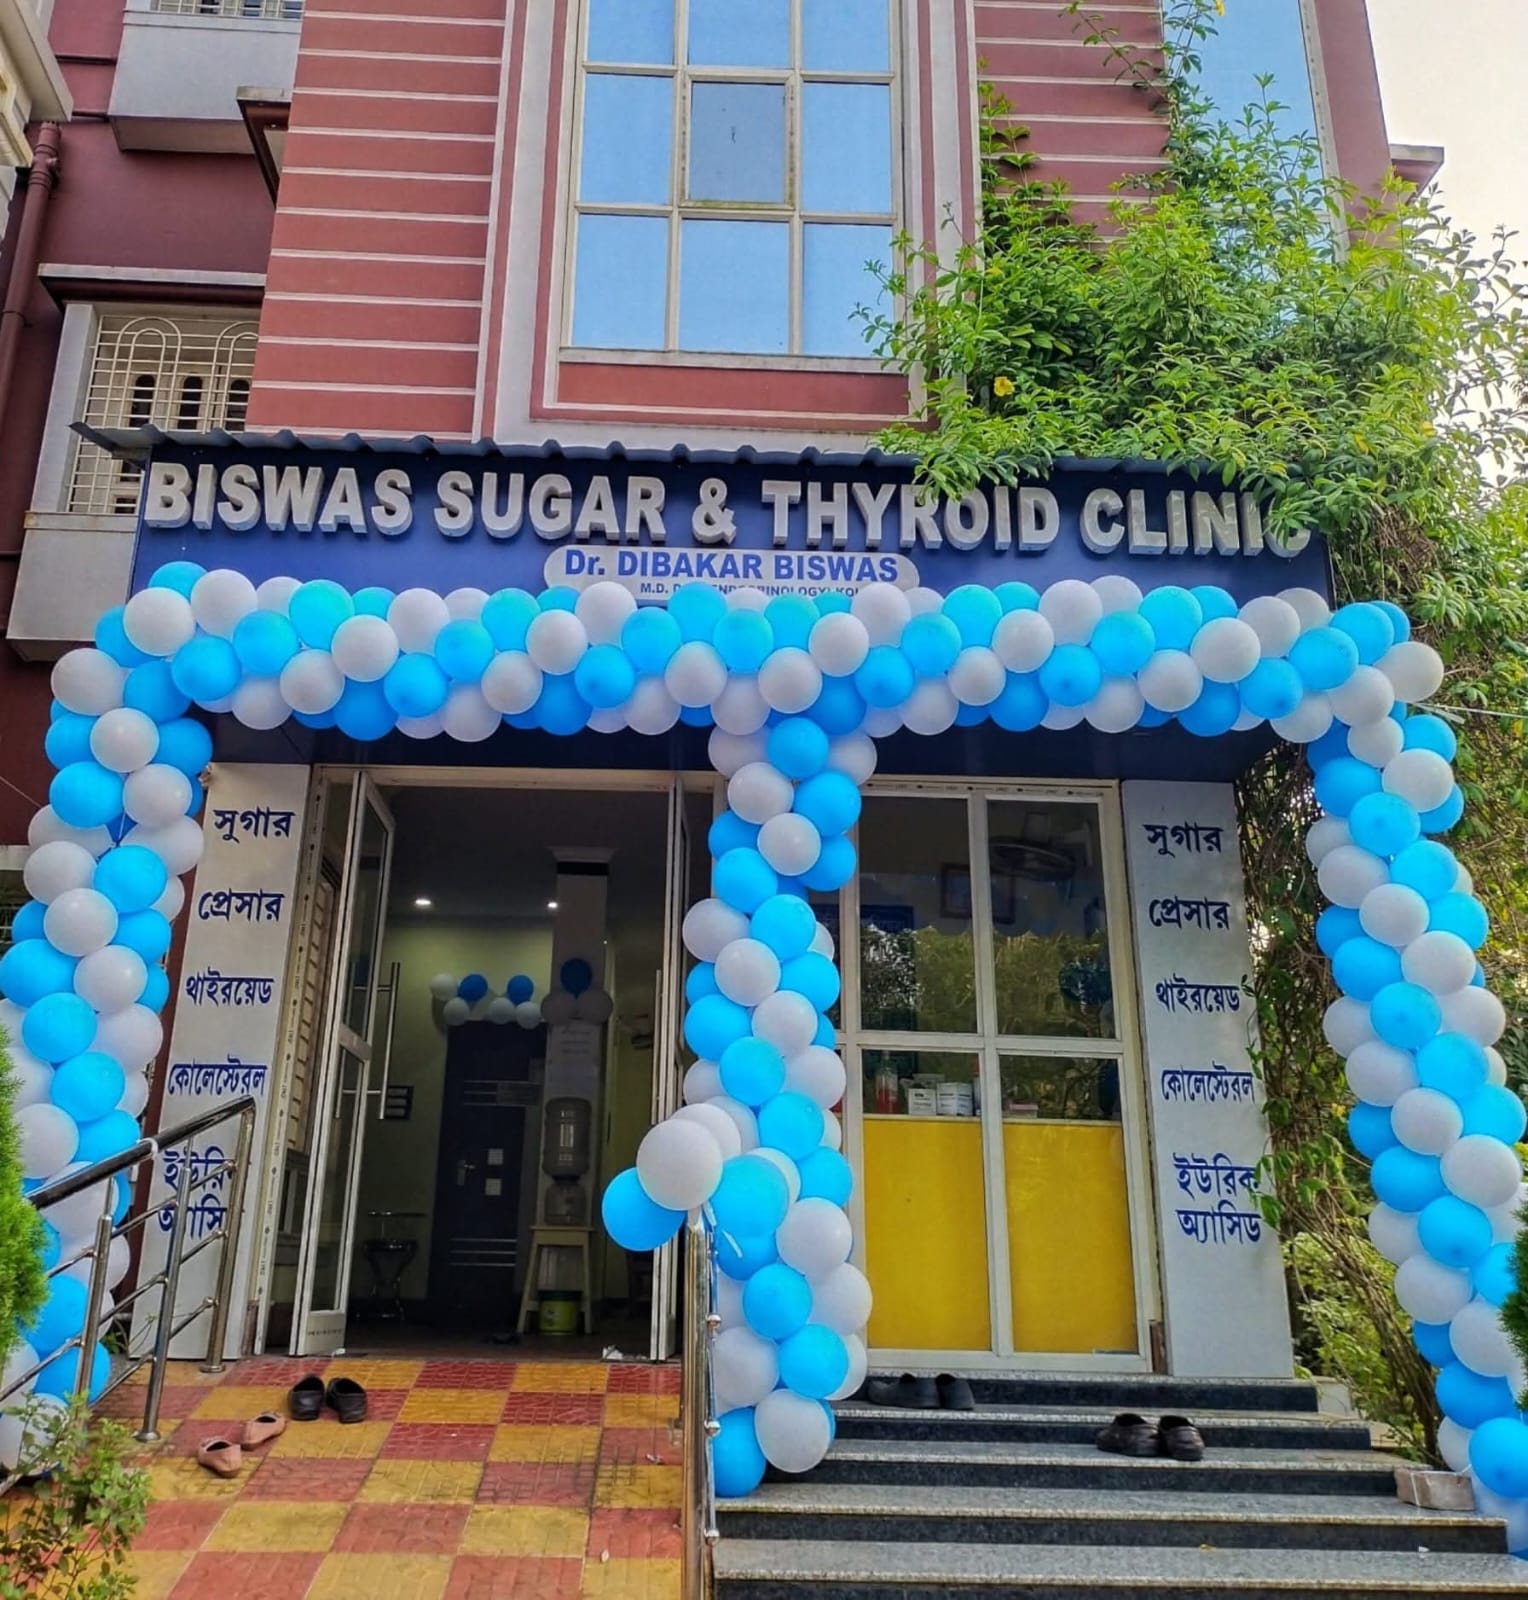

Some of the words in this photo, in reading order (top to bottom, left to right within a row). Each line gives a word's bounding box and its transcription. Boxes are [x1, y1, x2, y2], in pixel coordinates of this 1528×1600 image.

[145, 462, 412, 536] BISWAS
[434, 471, 665, 541] SUGAR
[691, 477, 736, 544] &
[762, 480, 1060, 551] THYROID
[565, 549, 605, 576] Dr.
[618, 550, 762, 580] DIBAKAR
[774, 555, 898, 583] BISWAS
[640, 582, 669, 595] M.D.
[213, 807, 295, 843] সুগার
[1144, 821, 1224, 857] সুগার
[199, 888, 285, 922] প্রেসার
[1150, 896, 1230, 931] প্রেসার
[185, 966, 274, 1006] থাইরয়েড
[1156, 973, 1241, 1013] থাইরয়েড
[168, 1053, 267, 1097] কোলেস্টেরল
[1161, 1061, 1255, 1104] কোলেস্টেরল
[163, 1146, 235, 1191] ইউরি
[1176, 1199, 1263, 1244] অ্যাসিড
